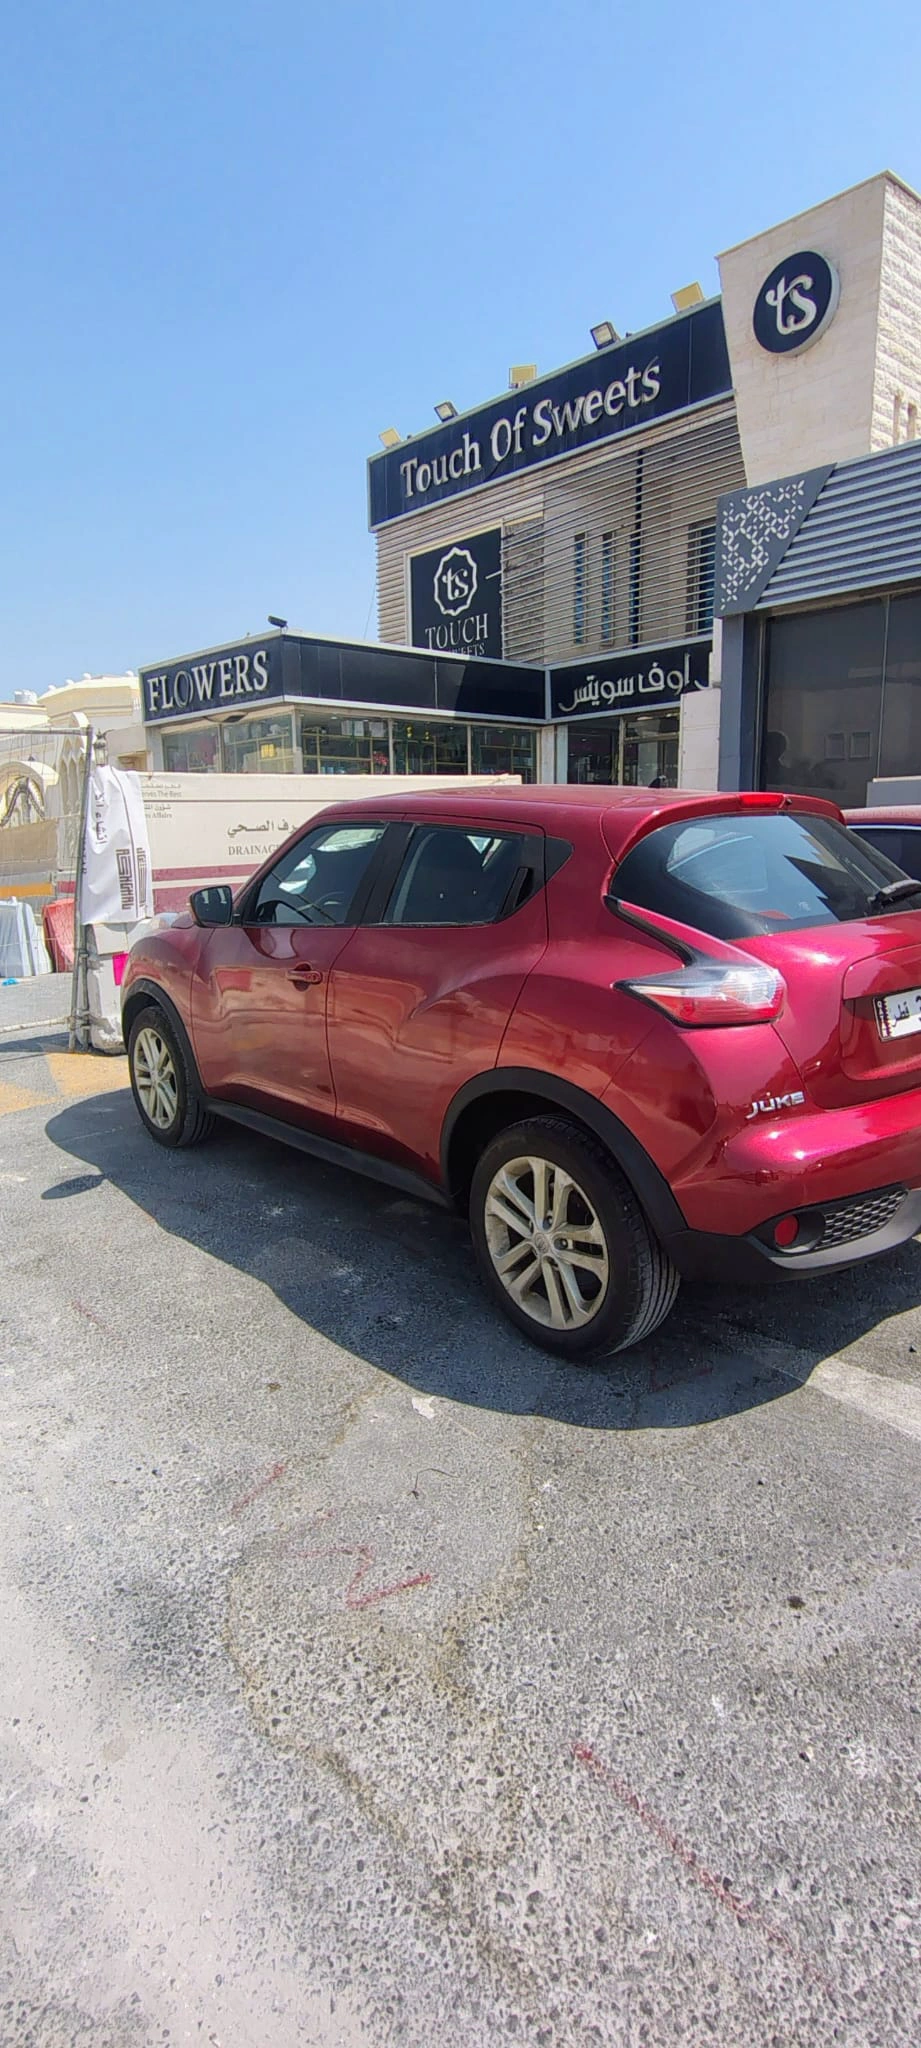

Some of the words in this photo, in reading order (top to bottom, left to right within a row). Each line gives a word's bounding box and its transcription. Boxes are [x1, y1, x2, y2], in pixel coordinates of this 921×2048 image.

[765, 274, 817, 335] ts
[401, 432, 482, 498] Touch
[490, 406, 526, 463] Of
[532, 361, 660, 446] Sweets
[441, 568, 469, 600] ts
[424, 613, 489, 650] TOUCH
[147, 650, 269, 712] FLOWERS
[227, 820, 275, 838] الصحي
[745, 1091, 805, 1119] JUKE
